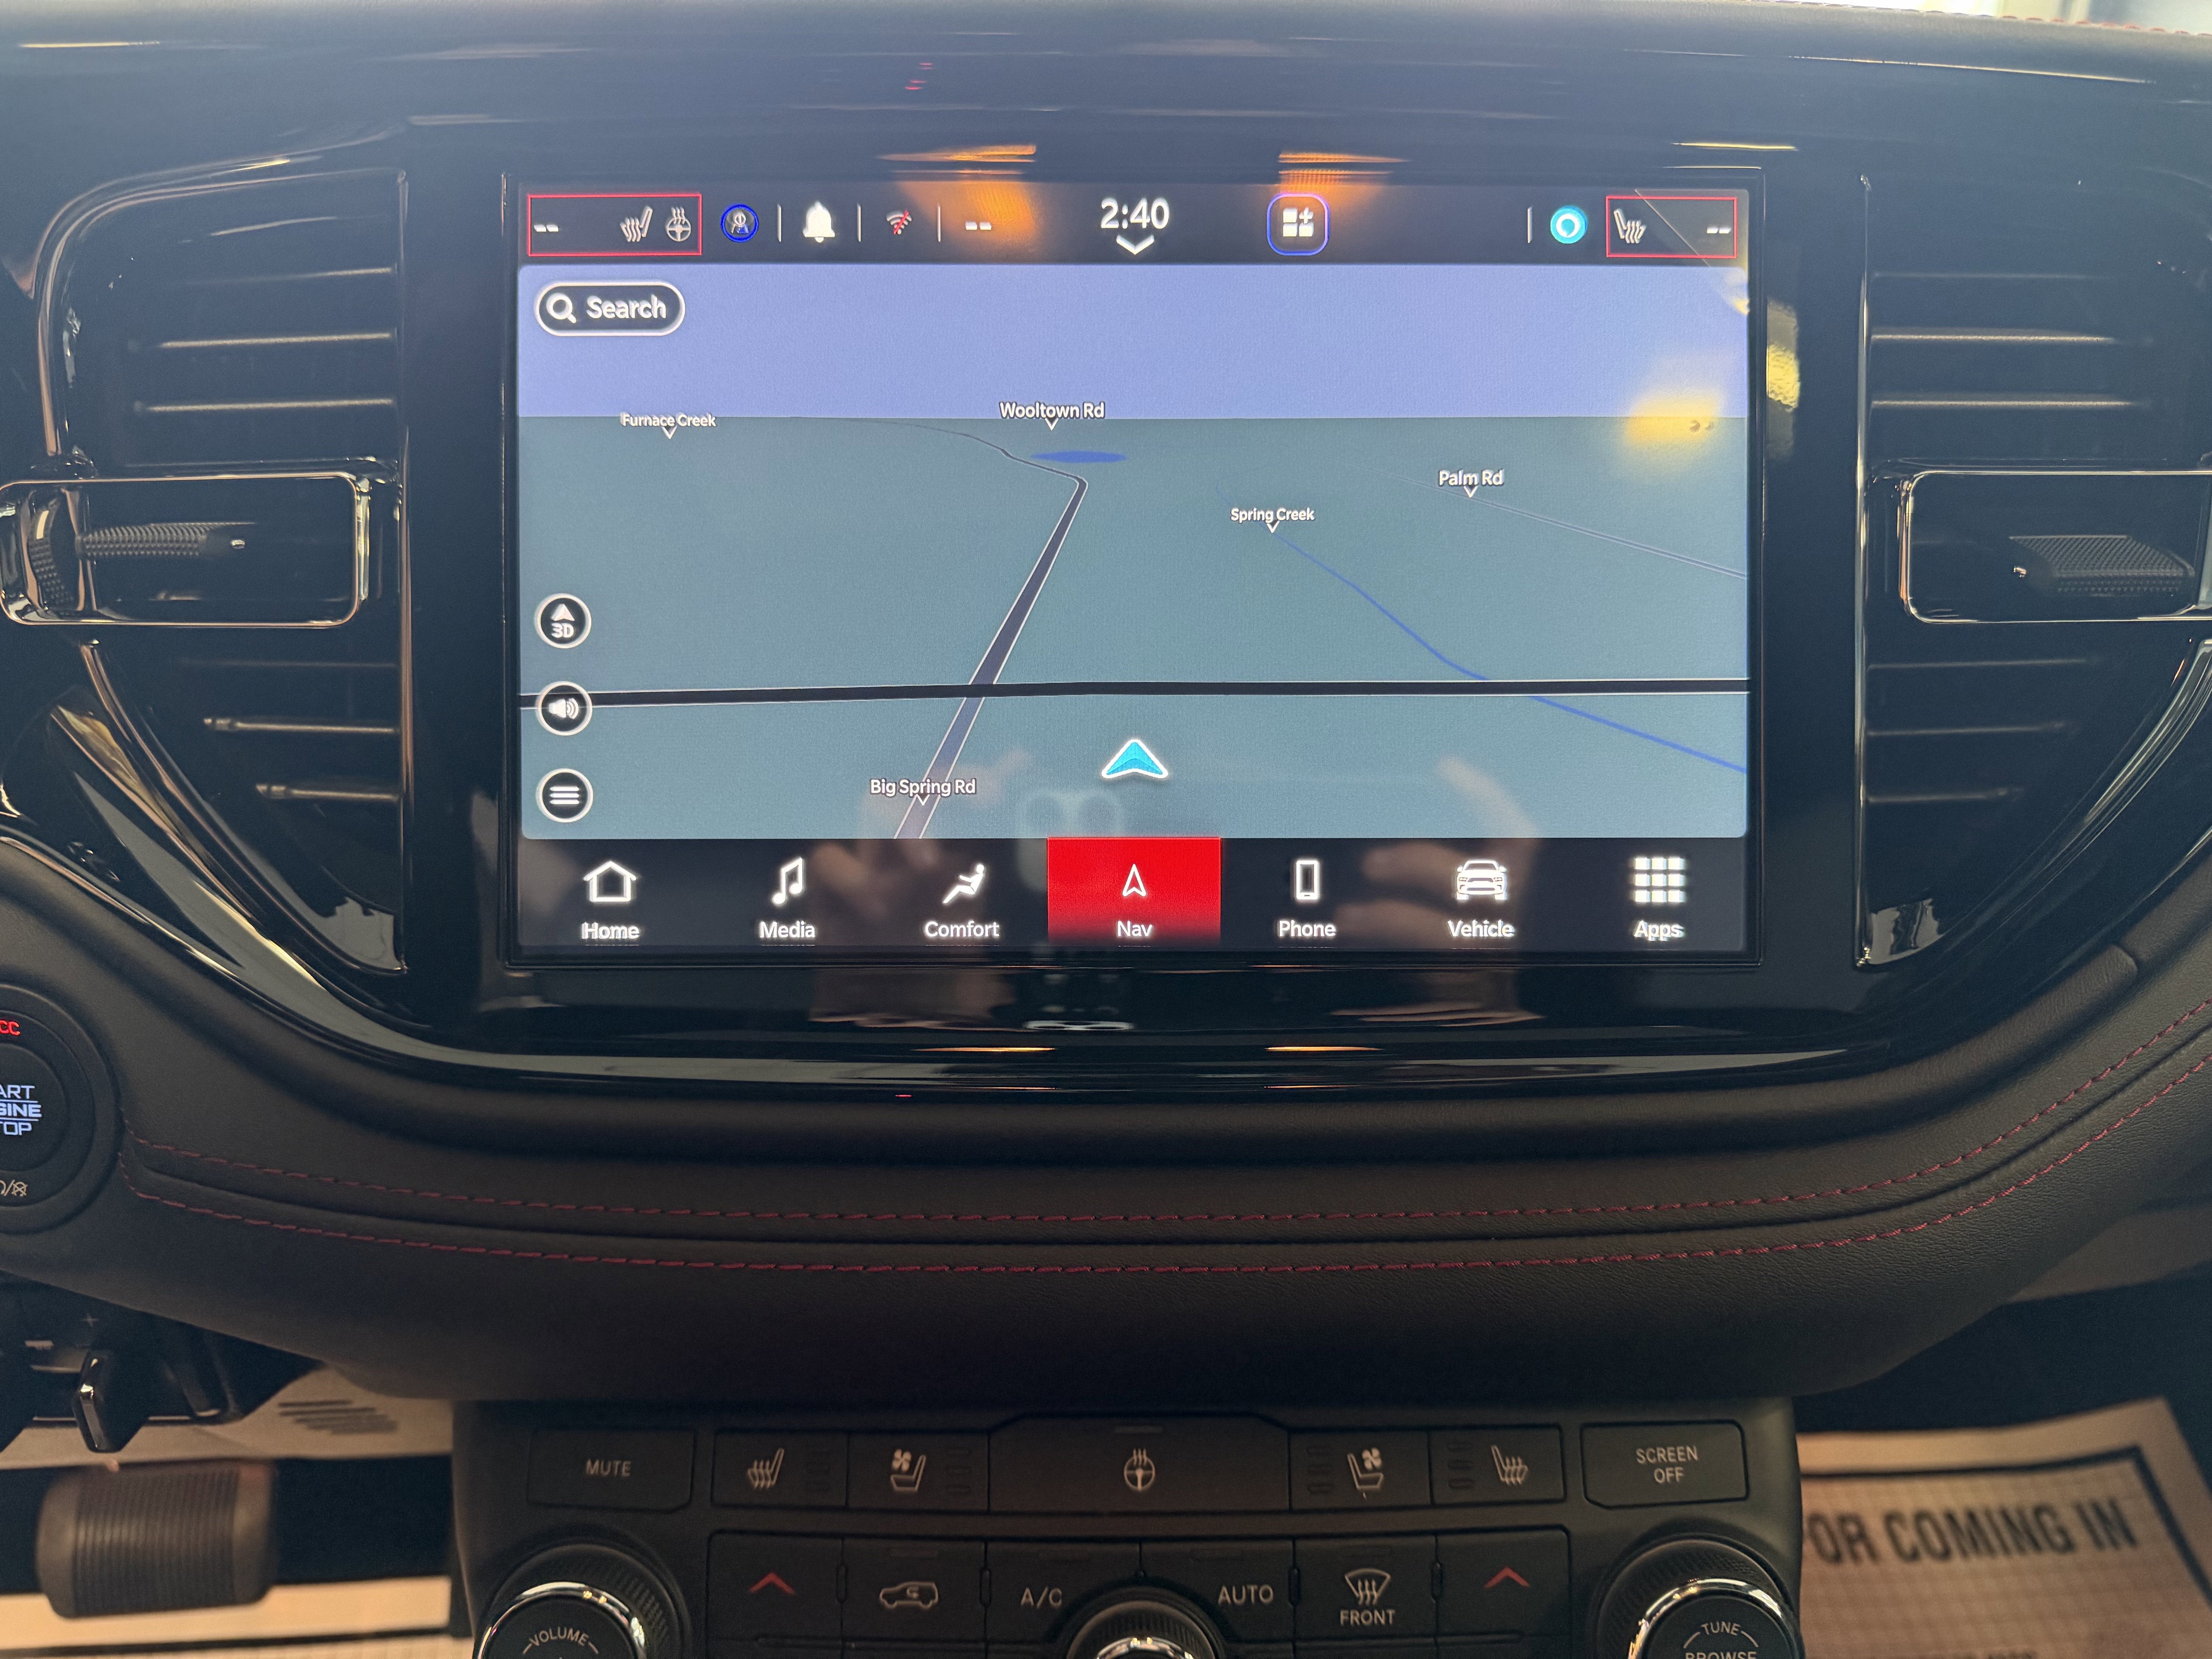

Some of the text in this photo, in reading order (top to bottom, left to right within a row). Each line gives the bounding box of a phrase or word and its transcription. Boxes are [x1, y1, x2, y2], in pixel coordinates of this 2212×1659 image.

[1101, 198, 1170, 229] 2:40
[586, 295, 667, 319] Search
[1000, 402, 1104, 418] Wooltown Rd
[621, 413, 716, 427] Furnace Creek
[1439, 469, 1504, 486] Palm Rd
[1231, 507, 1315, 523] Spring Creek
[551, 623, 574, 638] 3D
[871, 779, 975, 797] Big Spring Rd
[581, 922, 640, 939] Home
[759, 920, 816, 938] Media
[924, 920, 1000, 938] Comfort
[1117, 920, 1153, 937] Nav
[1279, 920, 1336, 937] Phone
[1447, 920, 1515, 938] Vehicle
[1633, 920, 1685, 941] Apps
[0, 1121, 32, 1135] OP
[1636, 1446, 1698, 1464] SCREEN
[586, 1459, 632, 1477] MUTE
[1654, 1467, 1684, 1484] OFF
[1883, 1503, 2076, 1563] COMING
[2074, 1497, 2138, 1550] IN
[1020, 1587, 1063, 1609] A/C
[1218, 1584, 1274, 1605] AUTO
[1340, 1609, 1395, 1626] FRONT
[529, 1626, 590, 1647] VOLUME
[1700, 1621, 1741, 1636] TUNE
